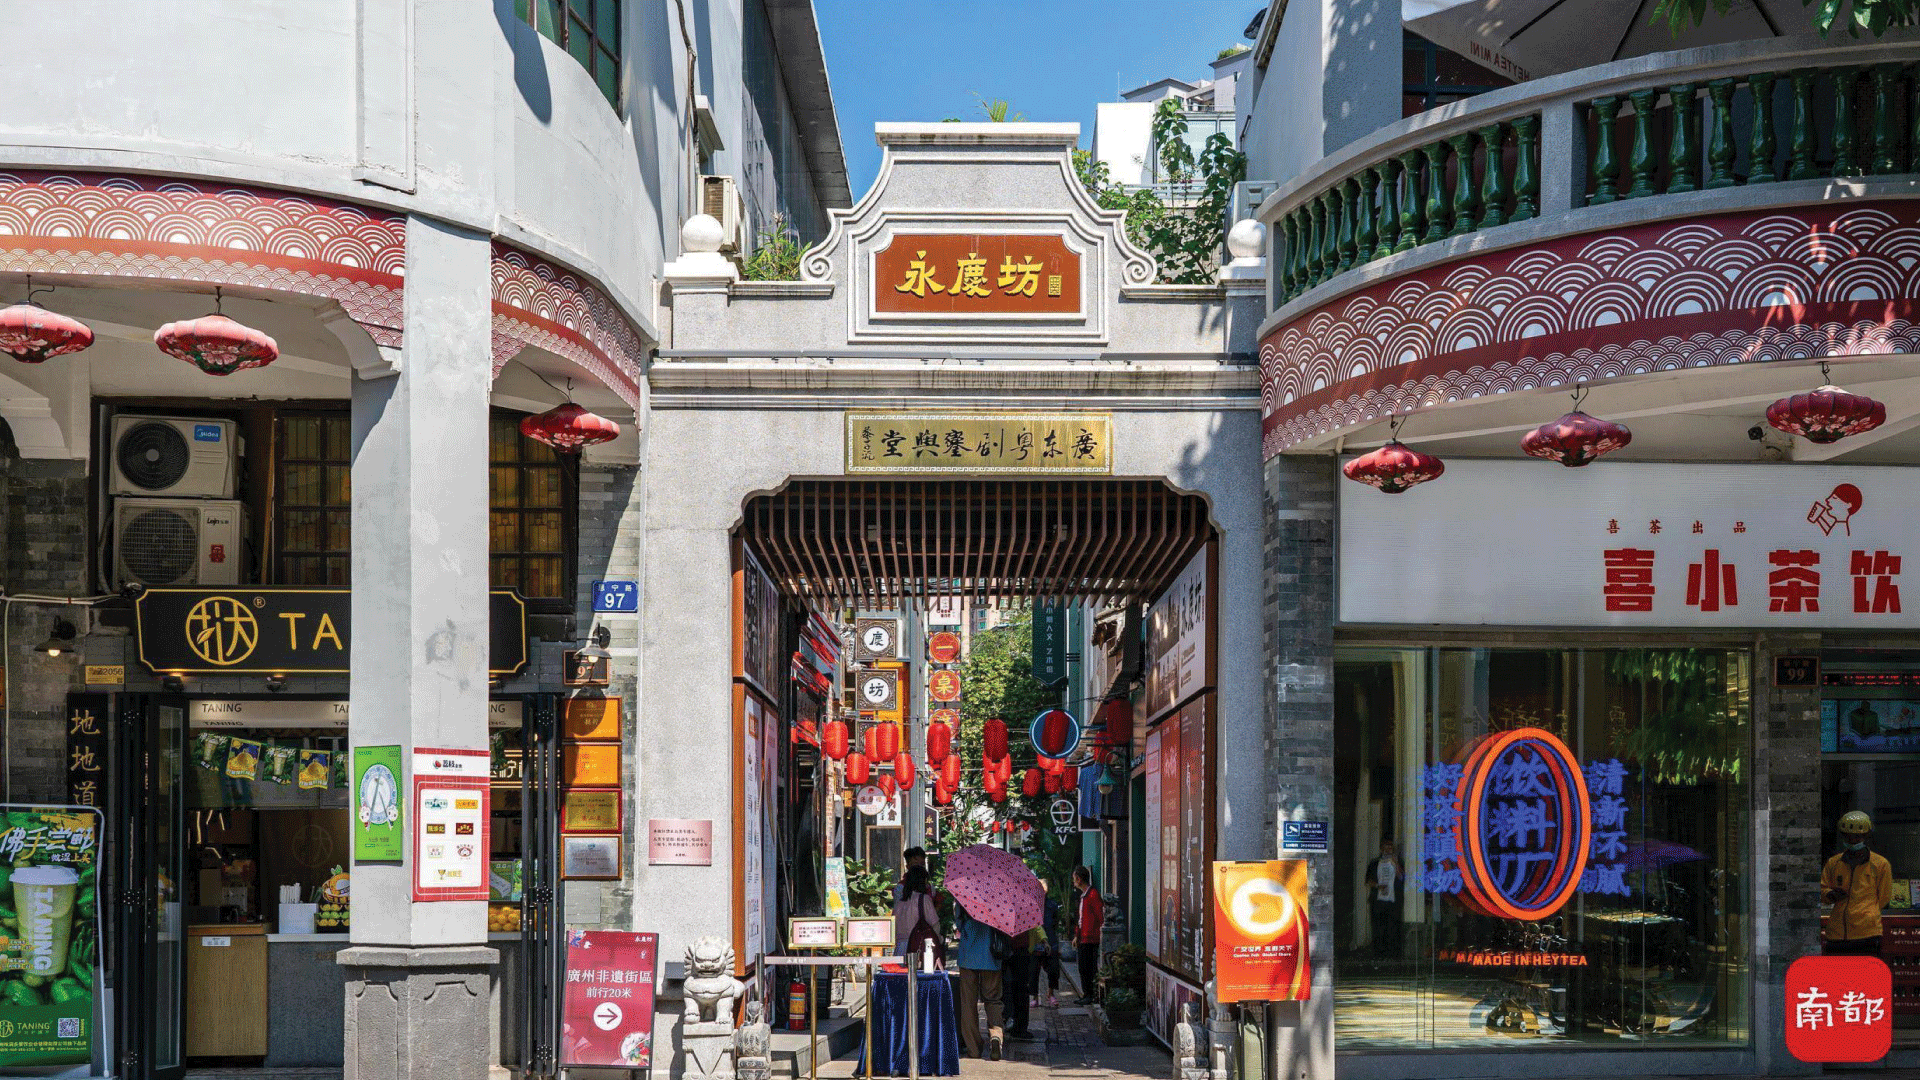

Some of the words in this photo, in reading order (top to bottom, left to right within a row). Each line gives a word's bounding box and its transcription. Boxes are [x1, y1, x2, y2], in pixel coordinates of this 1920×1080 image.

[894, 250, 1043, 297] 永慶坊
[1606, 519, 1747, 534] 喜茶出品
[1603, 548, 1902, 613] 喜小茶饮
[604, 592, 625, 608] 97
[202, 703, 242, 713] TANING
[1055, 826, 1077, 834] KFC
[1473, 955, 1511, 966] MADE
[1515, 955, 1530, 966] IN
[1532, 955, 1588, 966] HEYTEA
[567, 969, 653, 984] 廣州非遺街區
[586, 987, 632, 998] 前行20米
[17, 1022, 50, 1031] TANING
